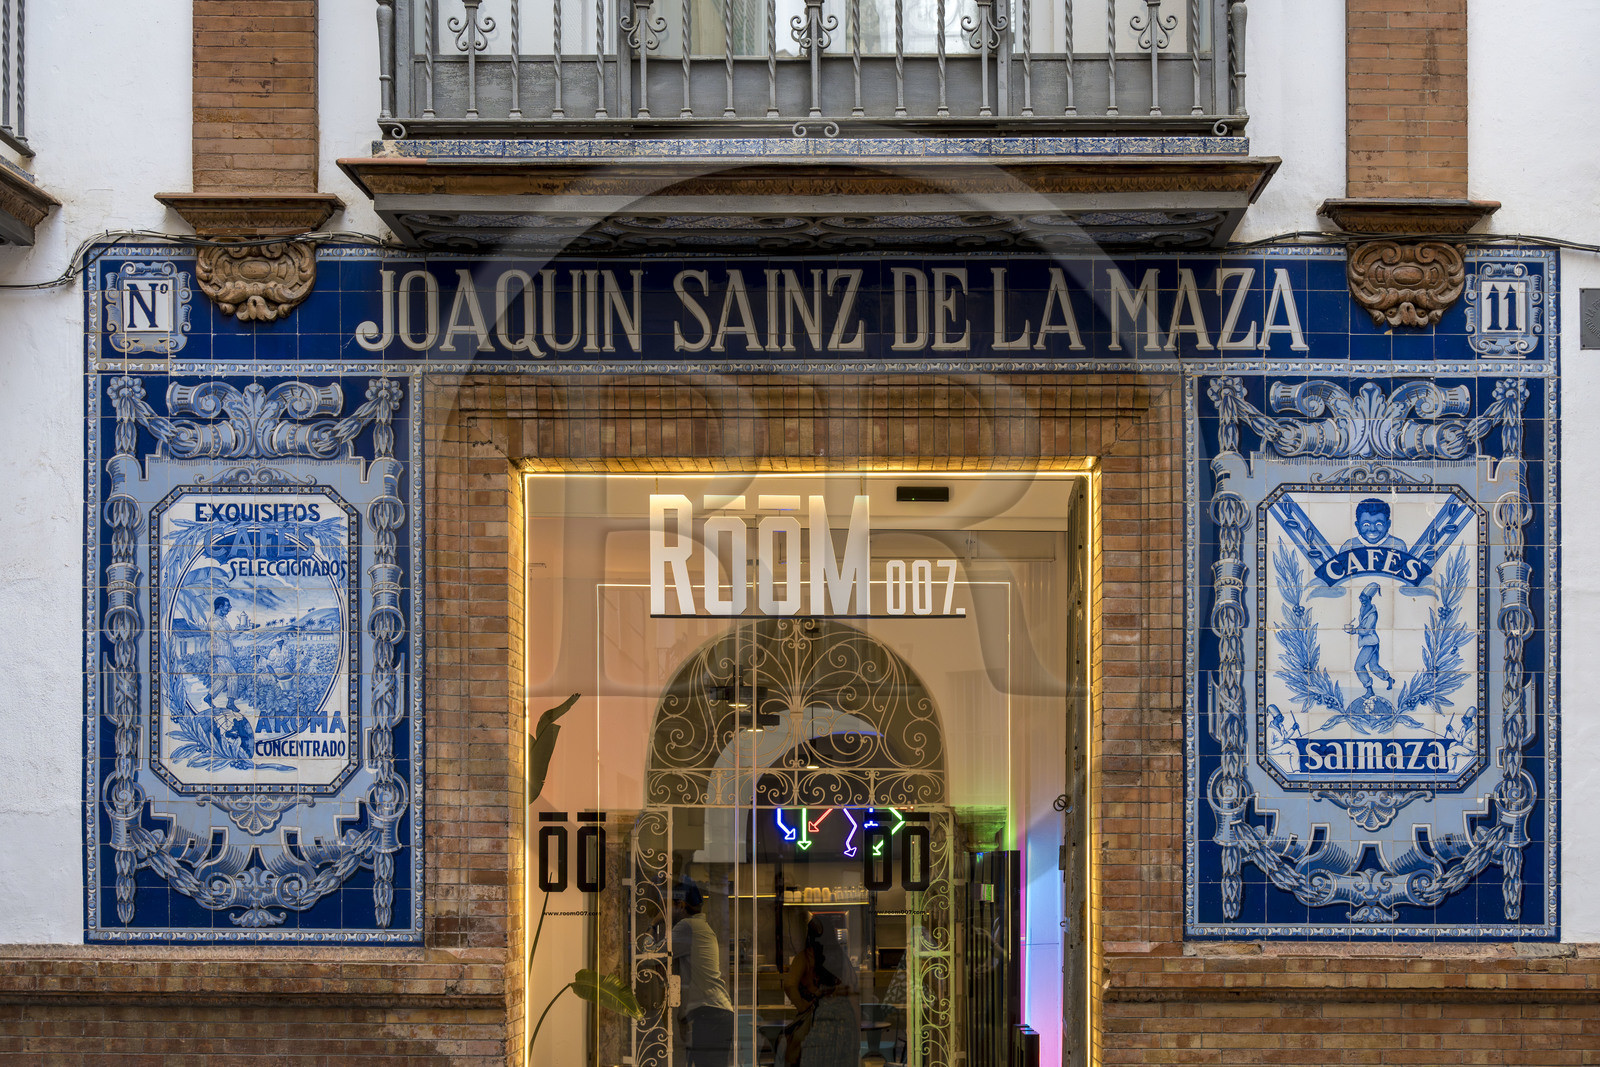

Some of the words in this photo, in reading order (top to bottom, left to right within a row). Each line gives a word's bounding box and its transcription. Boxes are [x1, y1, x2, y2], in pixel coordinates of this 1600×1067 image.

[355, 268, 644, 358] JOAQUIN
[673, 268, 865, 353] SAINZ
[890, 267, 971, 351] DE
[990, 267, 1086, 351] LA
[1105, 267, 1310, 351] MAZA
[1486, 284, 1522, 331] 11
[195, 503, 320, 522] EXQUISITOS
[229, 560, 348, 582] SELECCIONADOS
[255, 710, 346, 734] AROMA
[255, 740, 346, 757] CONCENTRADO
